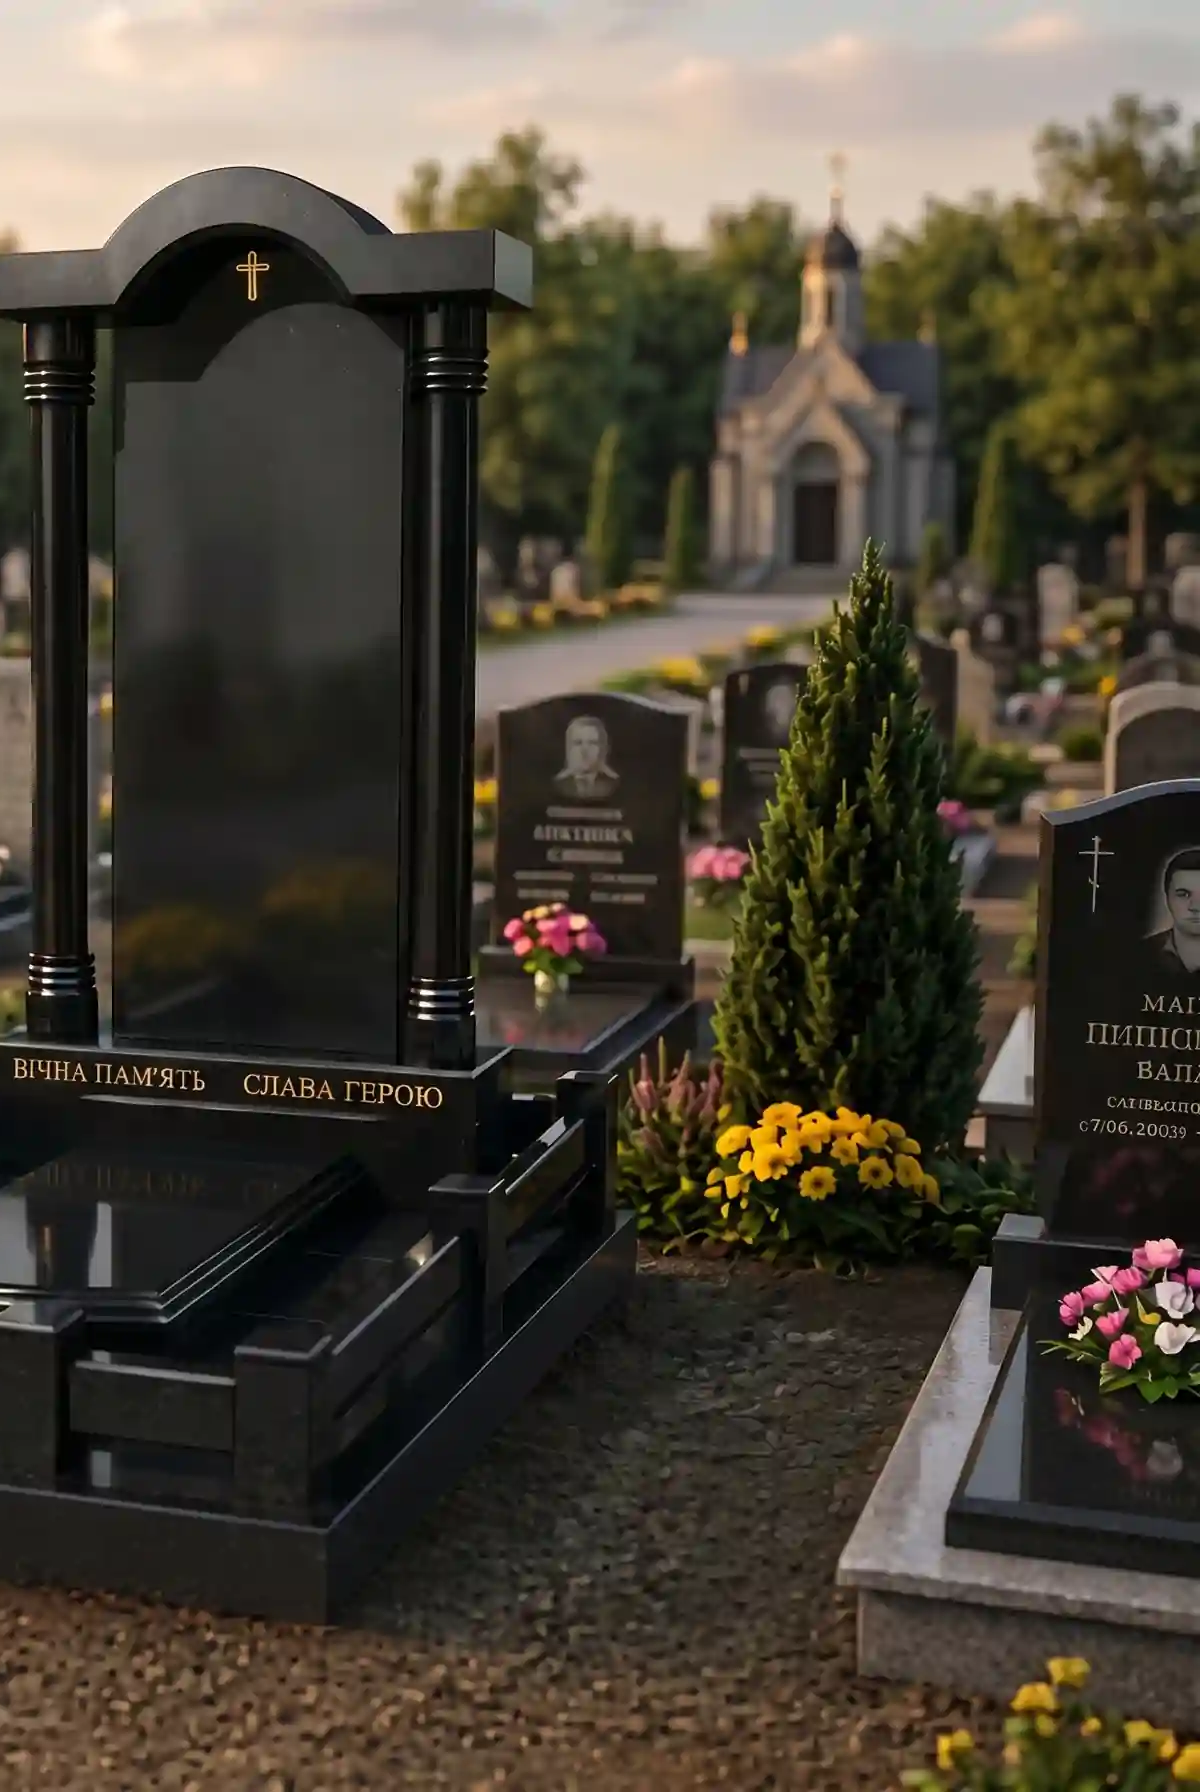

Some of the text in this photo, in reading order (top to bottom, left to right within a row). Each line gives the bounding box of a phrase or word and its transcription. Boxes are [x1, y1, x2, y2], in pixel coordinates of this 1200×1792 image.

[13, 1057, 443, 1109] ВІЧНА ПАМ’ЯТЬ СЛАВА ГЕРОЮ
